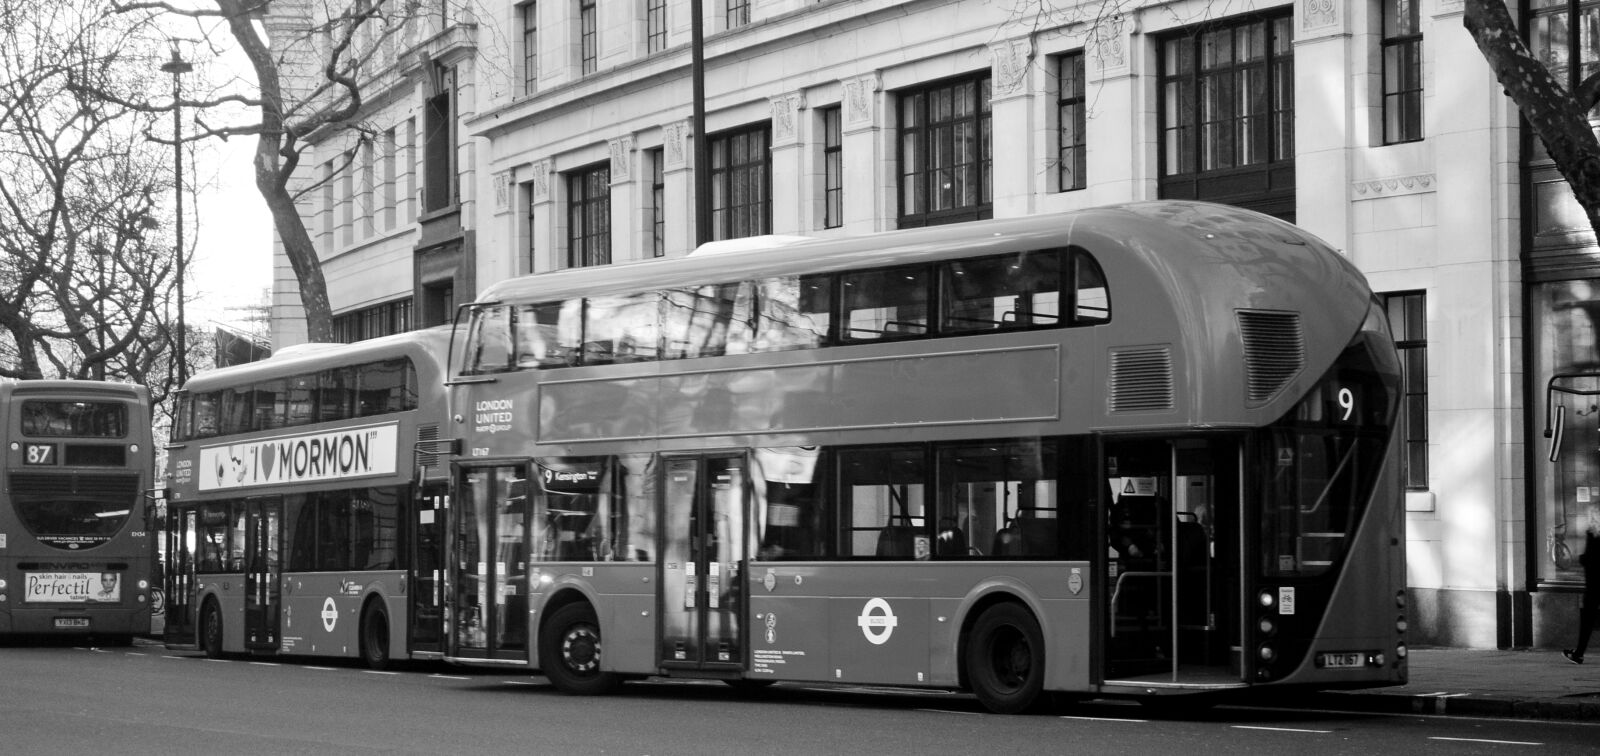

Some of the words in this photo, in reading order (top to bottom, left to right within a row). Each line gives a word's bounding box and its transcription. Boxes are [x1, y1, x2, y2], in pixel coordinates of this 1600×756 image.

[476, 400, 513, 411] LONDON
[1339, 388, 1353, 420] 9
[476, 412, 512, 423] UNITED
[27, 446, 51, 463] 87
[545, 470, 553, 483] 9
[555, 471, 588, 483] Kensington
[28, 575, 94, 598] Perfectil
